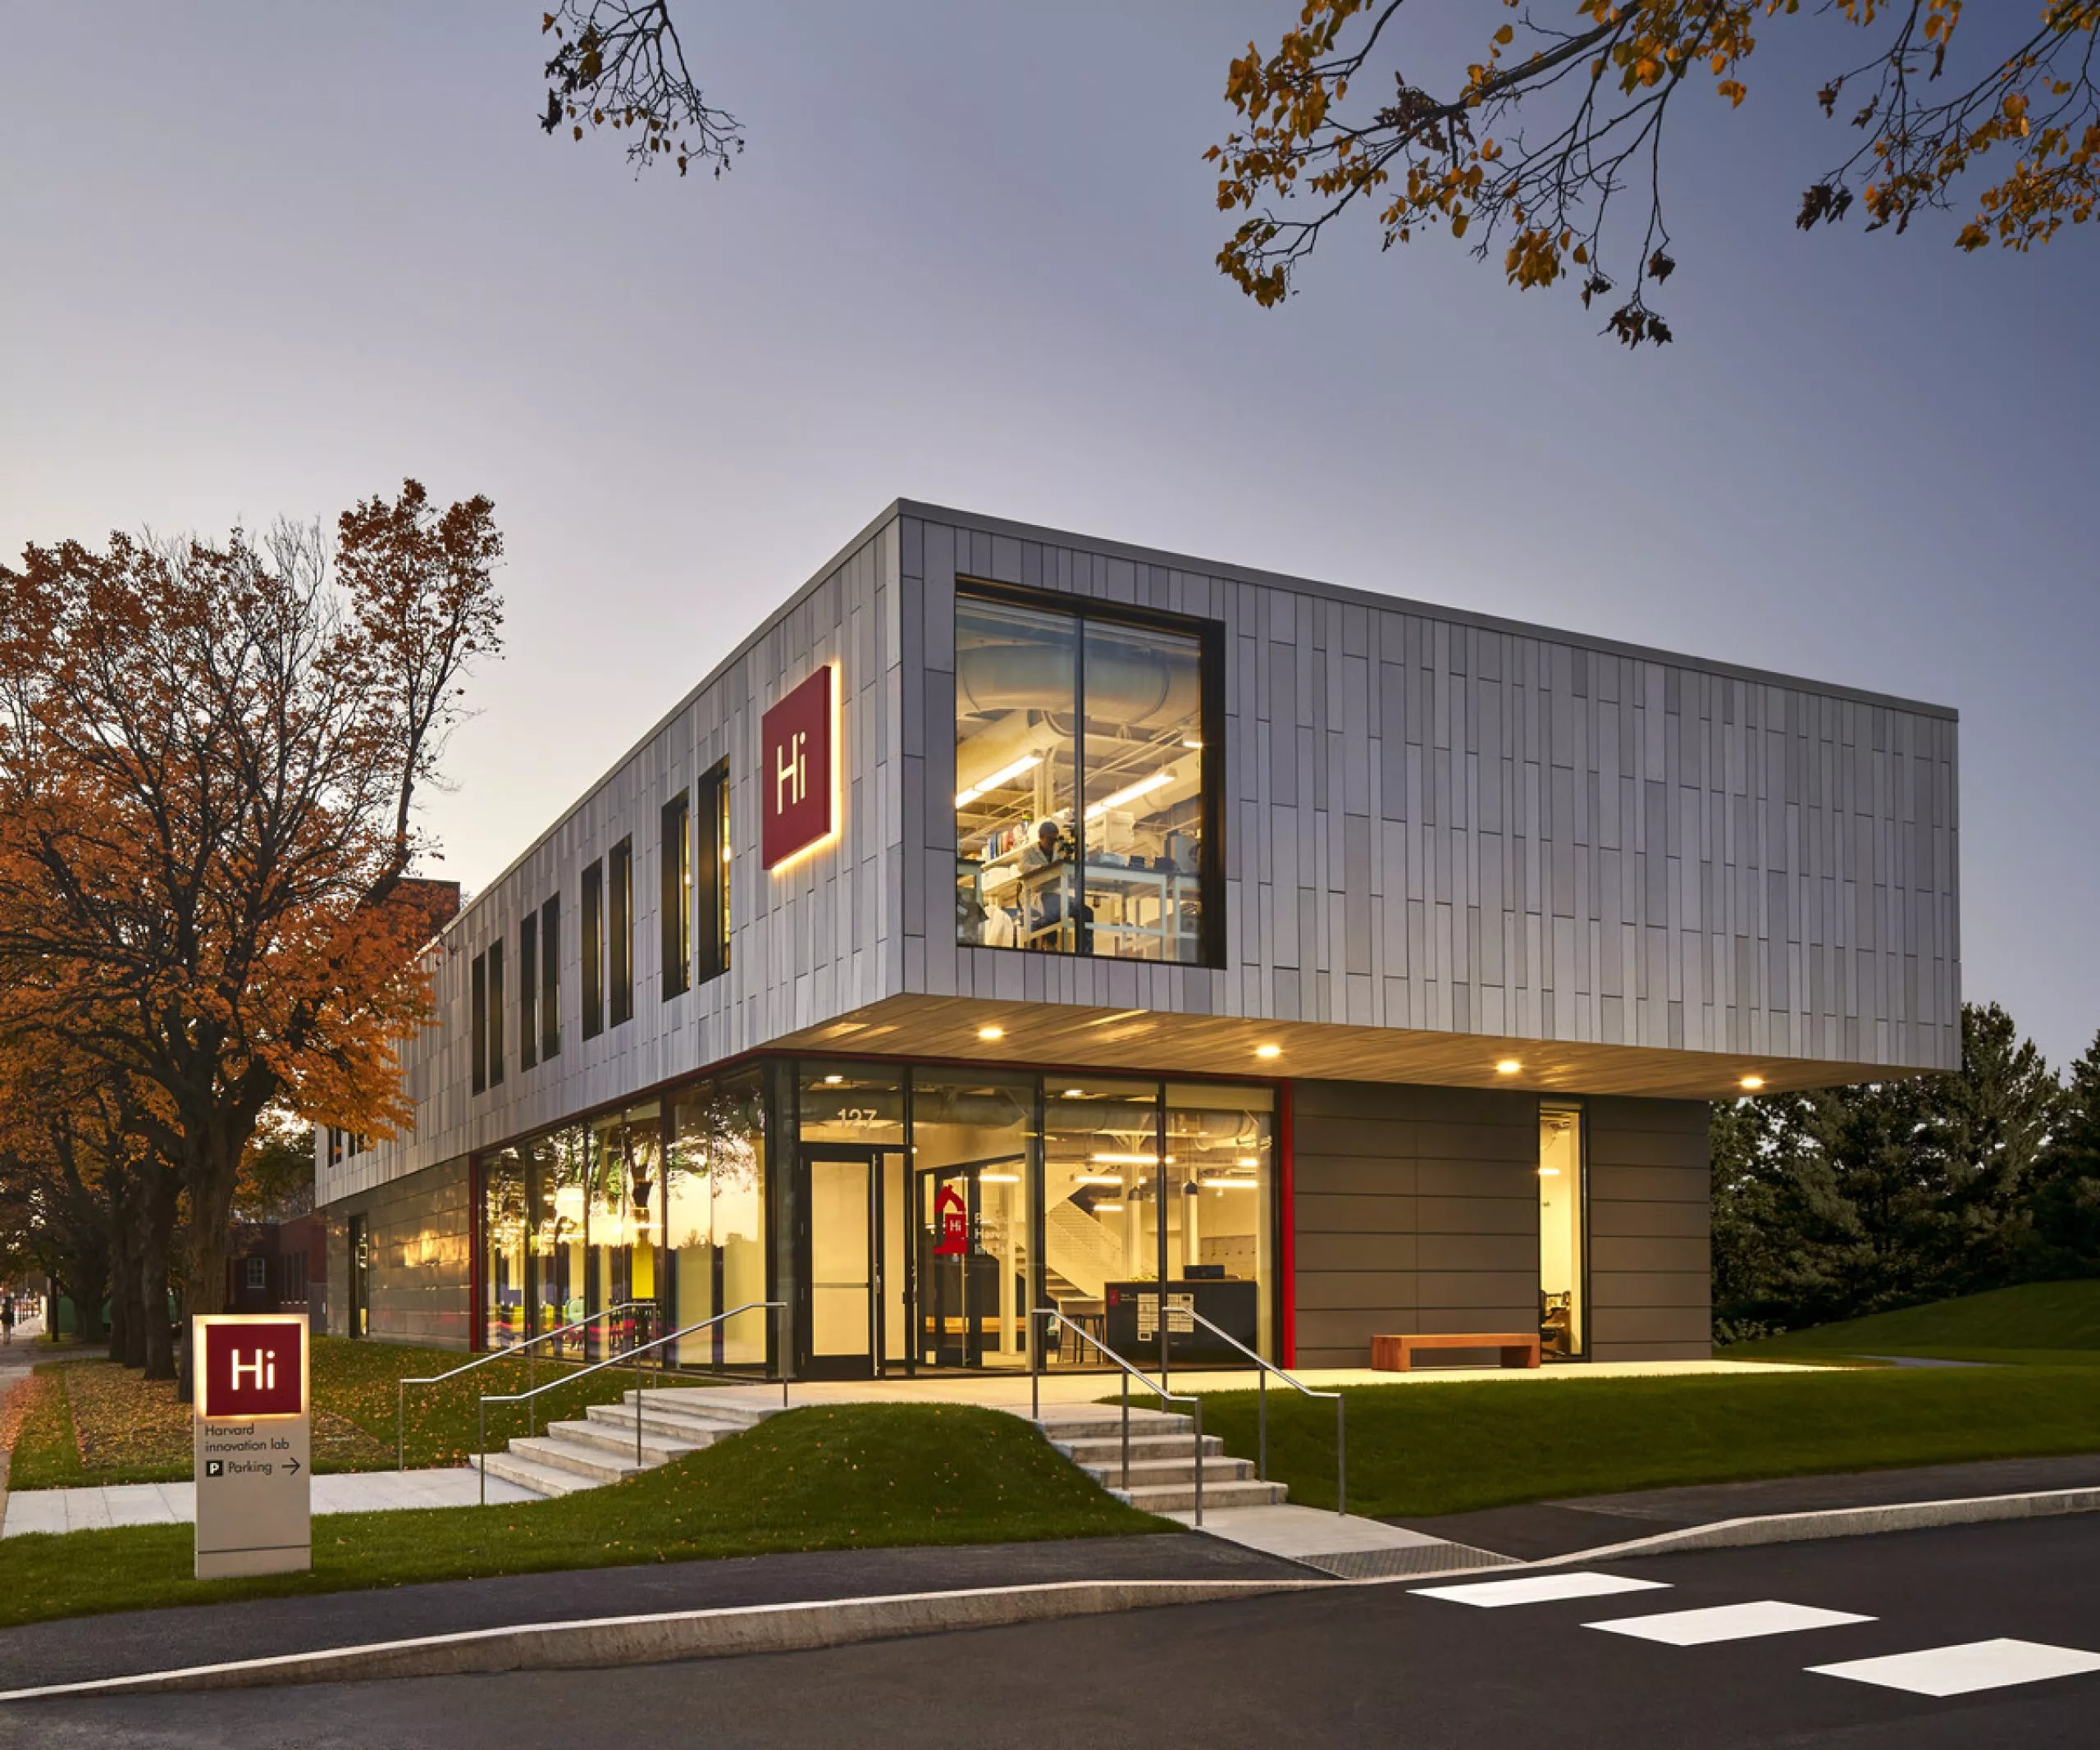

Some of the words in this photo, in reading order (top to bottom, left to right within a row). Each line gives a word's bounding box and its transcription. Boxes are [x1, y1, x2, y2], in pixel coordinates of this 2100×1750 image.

[776, 731, 806, 815] Hi
[838, 1108, 878, 1129] 127
[231, 1348, 276, 1391] Hi
[205, 1422, 255, 1437] Harvard
[205, 1441, 267, 1453] innovation
[271, 1437, 290, 1451] lab
[209, 1462, 220, 1474] P
[228, 1460, 273, 1476] Parking
